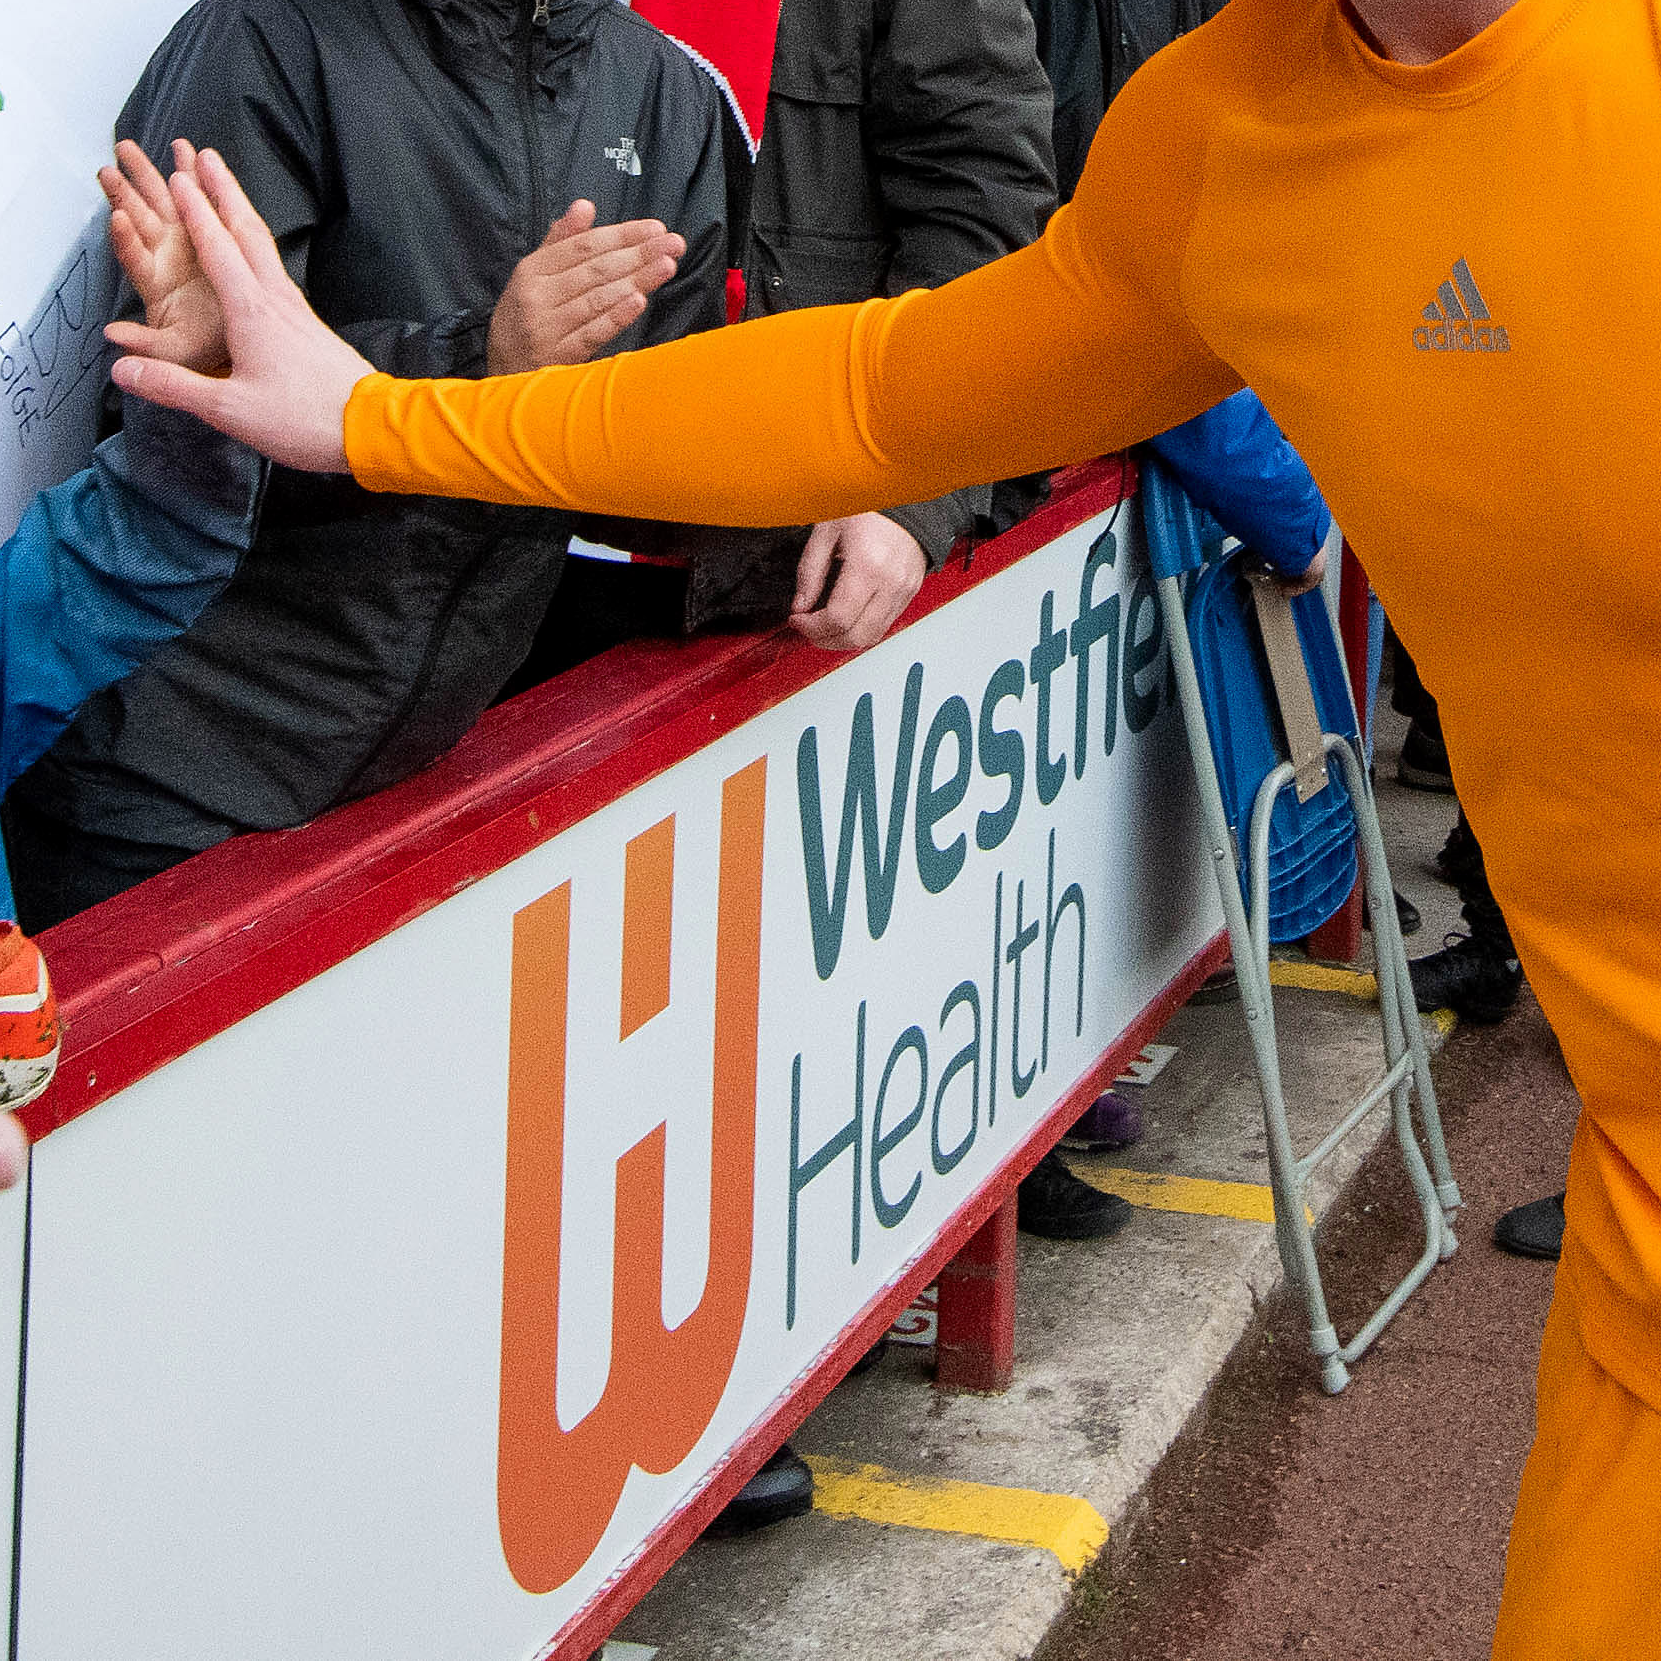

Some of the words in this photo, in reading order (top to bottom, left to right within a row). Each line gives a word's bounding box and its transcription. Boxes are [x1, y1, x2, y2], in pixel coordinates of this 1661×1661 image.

[1413, 318, 1510, 352] adidas
[796, 530, 1179, 981] Westfie
[786, 830, 1088, 1331] Health
